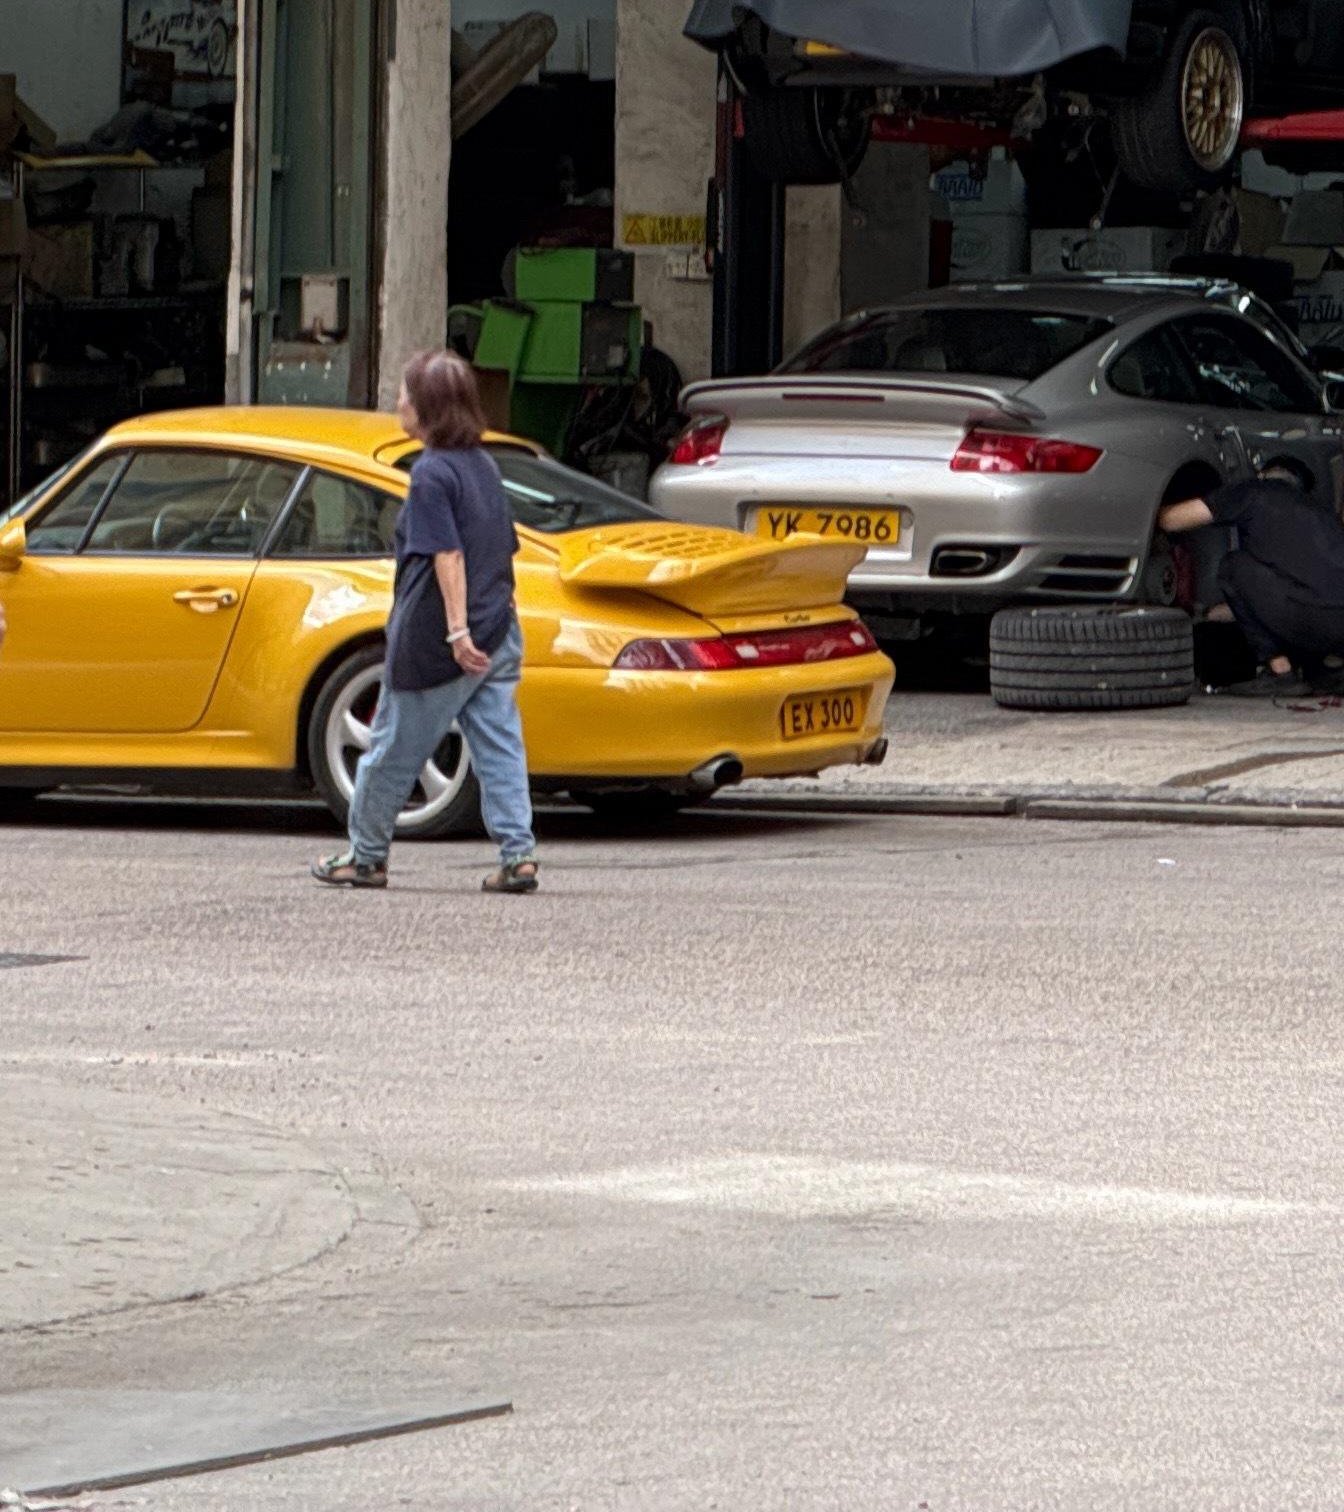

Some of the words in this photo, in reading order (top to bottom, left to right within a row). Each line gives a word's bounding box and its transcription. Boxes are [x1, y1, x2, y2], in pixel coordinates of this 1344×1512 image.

[768, 512, 803, 538] YK
[816, 512, 892, 541] 7986
[791, 699, 815, 733] EX
[820, 696, 854, 728] 300
